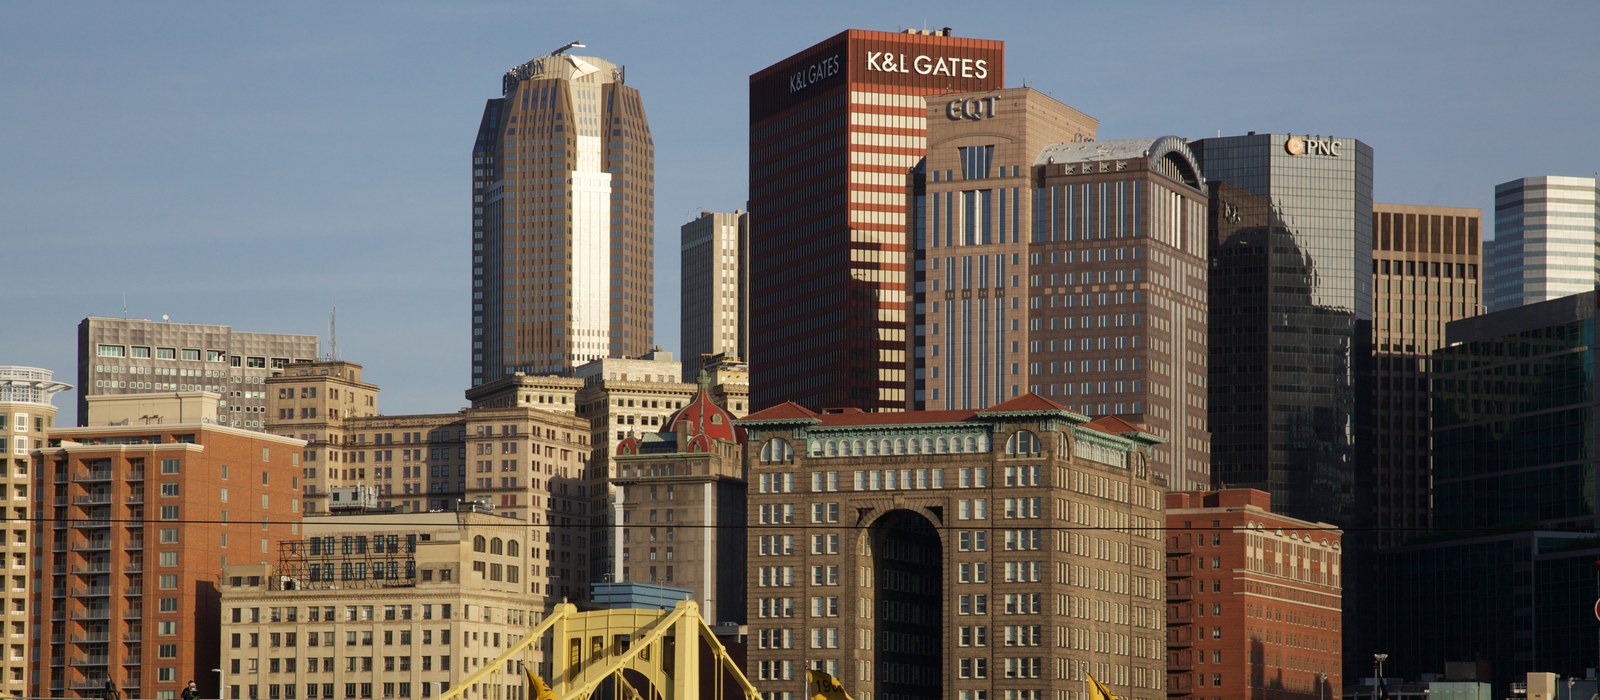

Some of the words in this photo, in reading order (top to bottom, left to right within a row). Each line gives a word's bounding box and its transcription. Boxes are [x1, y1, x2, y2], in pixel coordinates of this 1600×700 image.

[789, 71, 808, 94] K&L
[808, 54, 840, 84] GATES
[867, 51, 909, 73] K&L
[914, 54, 988, 79] GATES
[945, 94, 1002, 121] EQT
[1304, 139, 1342, 156] PNC
